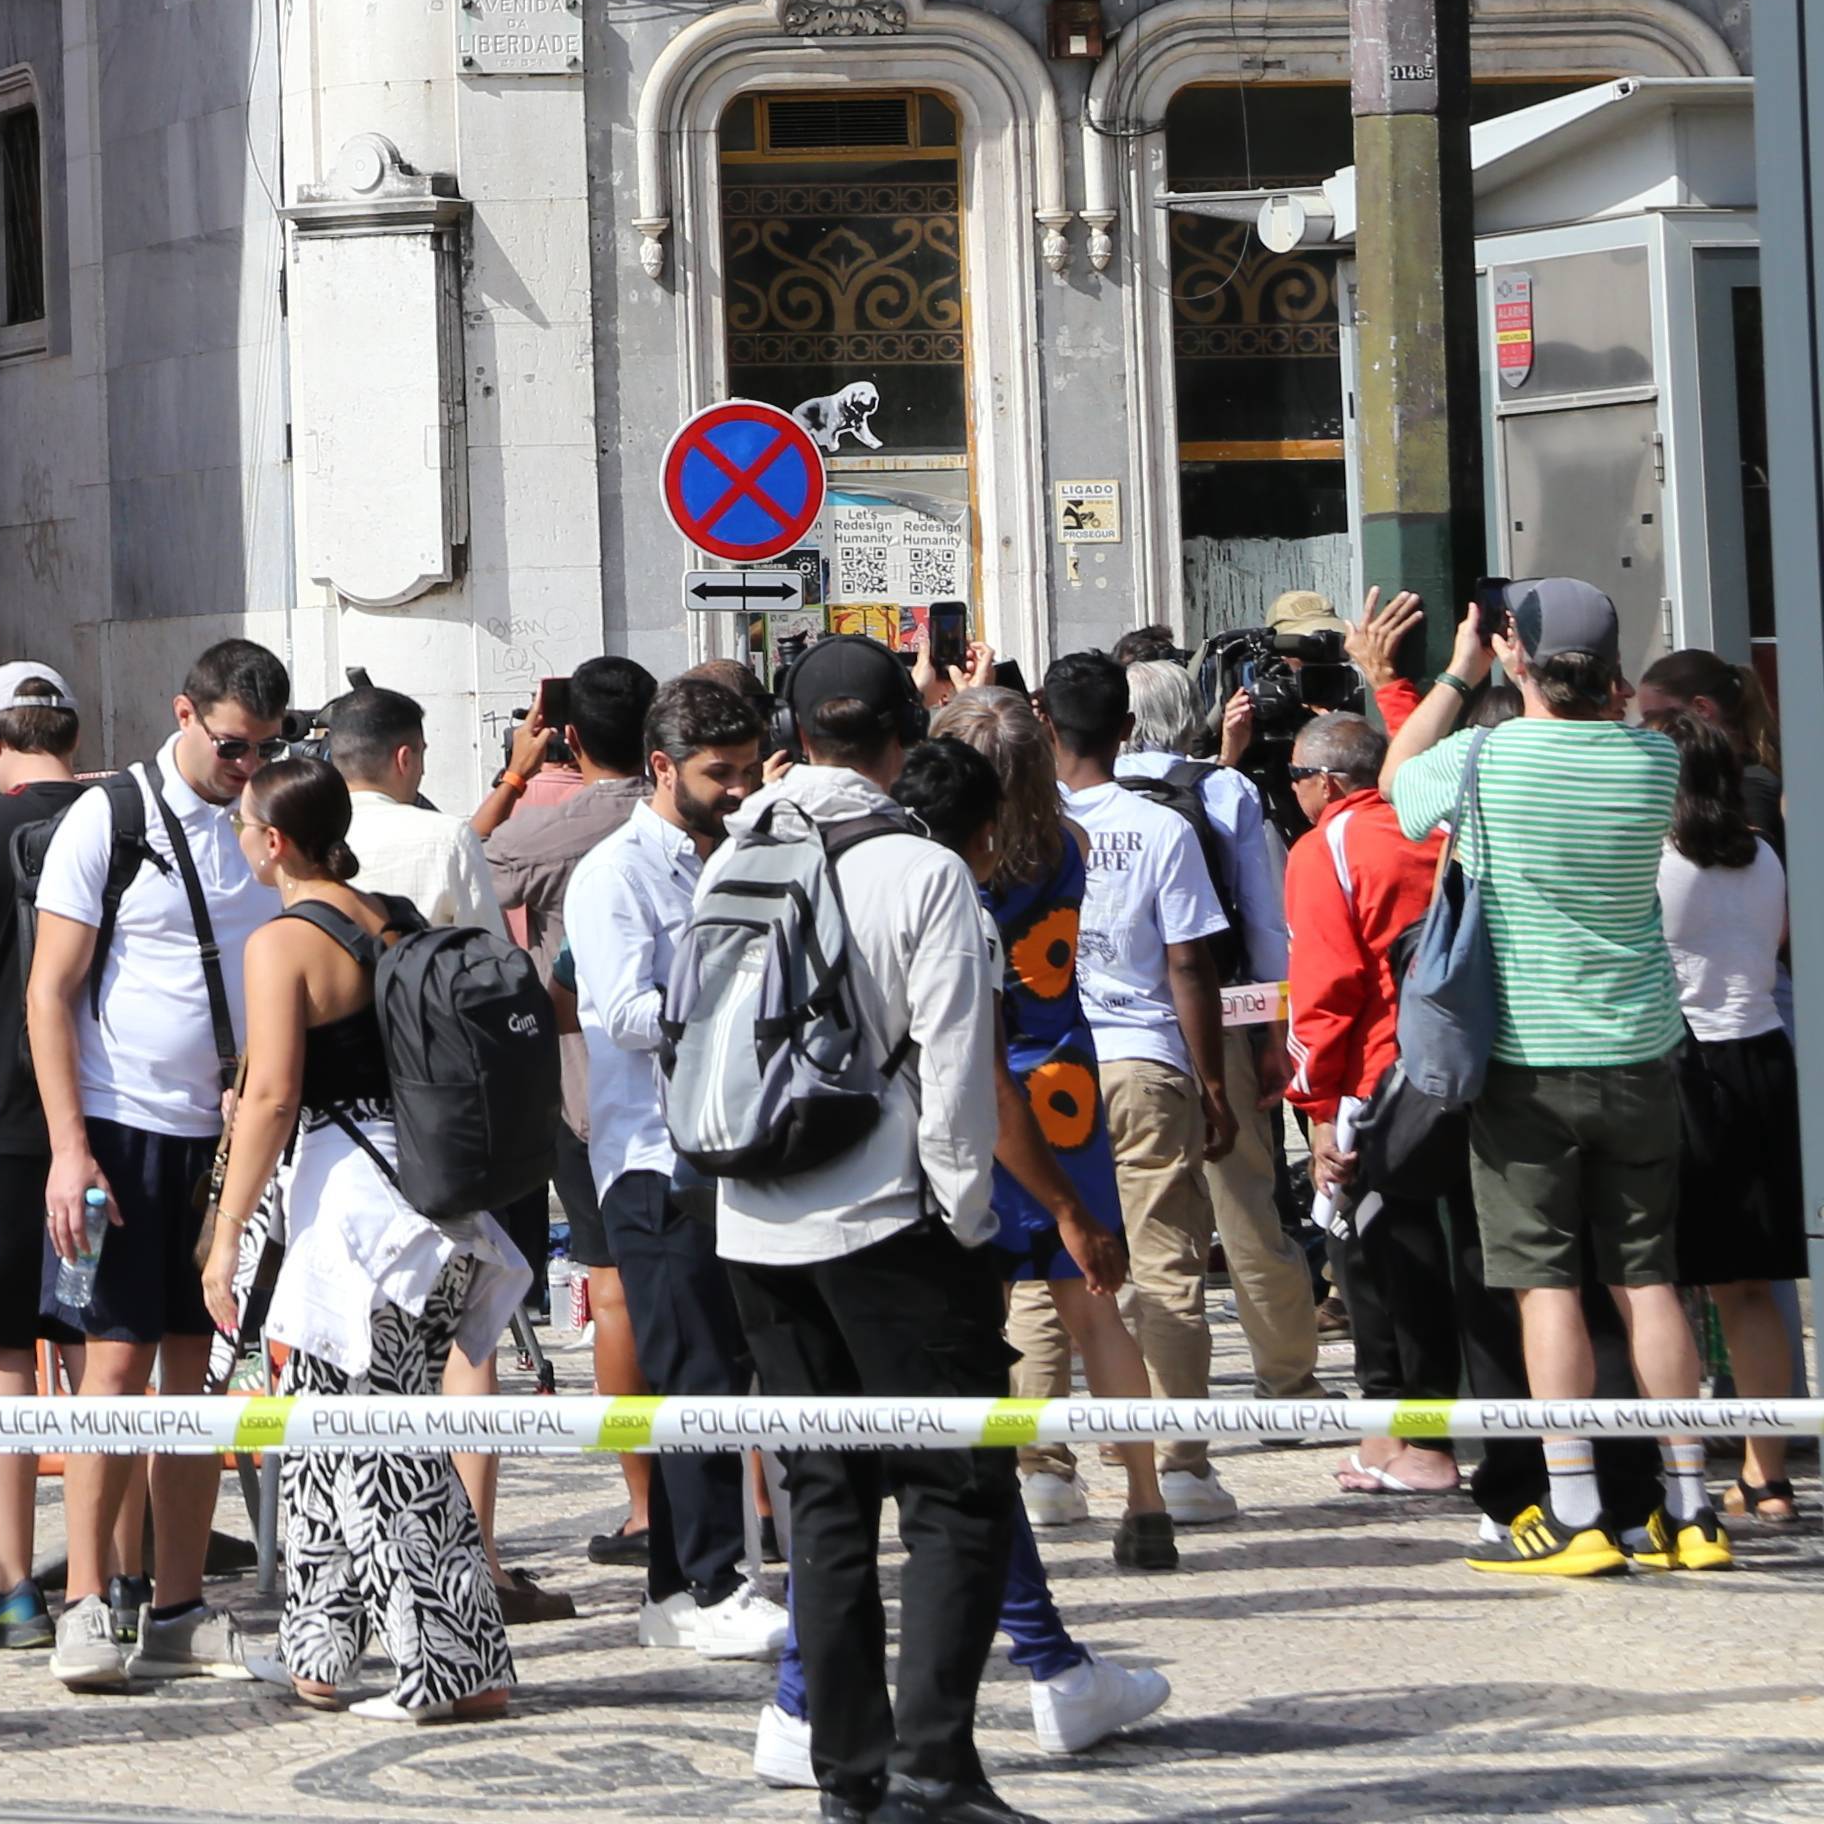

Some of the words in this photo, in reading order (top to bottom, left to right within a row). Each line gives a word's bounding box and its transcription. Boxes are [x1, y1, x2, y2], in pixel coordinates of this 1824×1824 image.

[507, 19, 527, 29] DA
[458, 35, 578, 54] LIBERDADE
[1393, 65, 1433, 80] 11485
[1062, 485, 1113, 494] LIGADO
[849, 510, 877, 519] Let's
[834, 521, 892, 532] Redesign
[904, 523, 961, 534] Redesign
[1063, 530, 1115, 538] PROSEGUR
[834, 534, 893, 546] Humanity
[903, 536, 962, 549] Humanity
[71, 1411, 213, 1435] MUNICIPAL
[239, 1416, 283, 1429] LISBOA
[312, 1405, 416, 1435] POLÍCIA
[425, 1410, 574, 1435] MUNICIPAL
[603, 1414, 649, 1429] LISBOA
[679, 1404, 788, 1434] POLÍCIA
[798, 1407, 956, 1433] MUNICIPAL
[986, 1413, 1034, 1428] LISBOA
[1067, 1403, 1184, 1432] POLÍCIA
[1193, 1404, 1361, 1432] MUNICIPAL
[1393, 1411, 1446, 1426] LISBOA
[1479, 1401, 1606, 1432] POLÍCIA
[1614, 1400, 1795, 1430] MUNICIPAL
